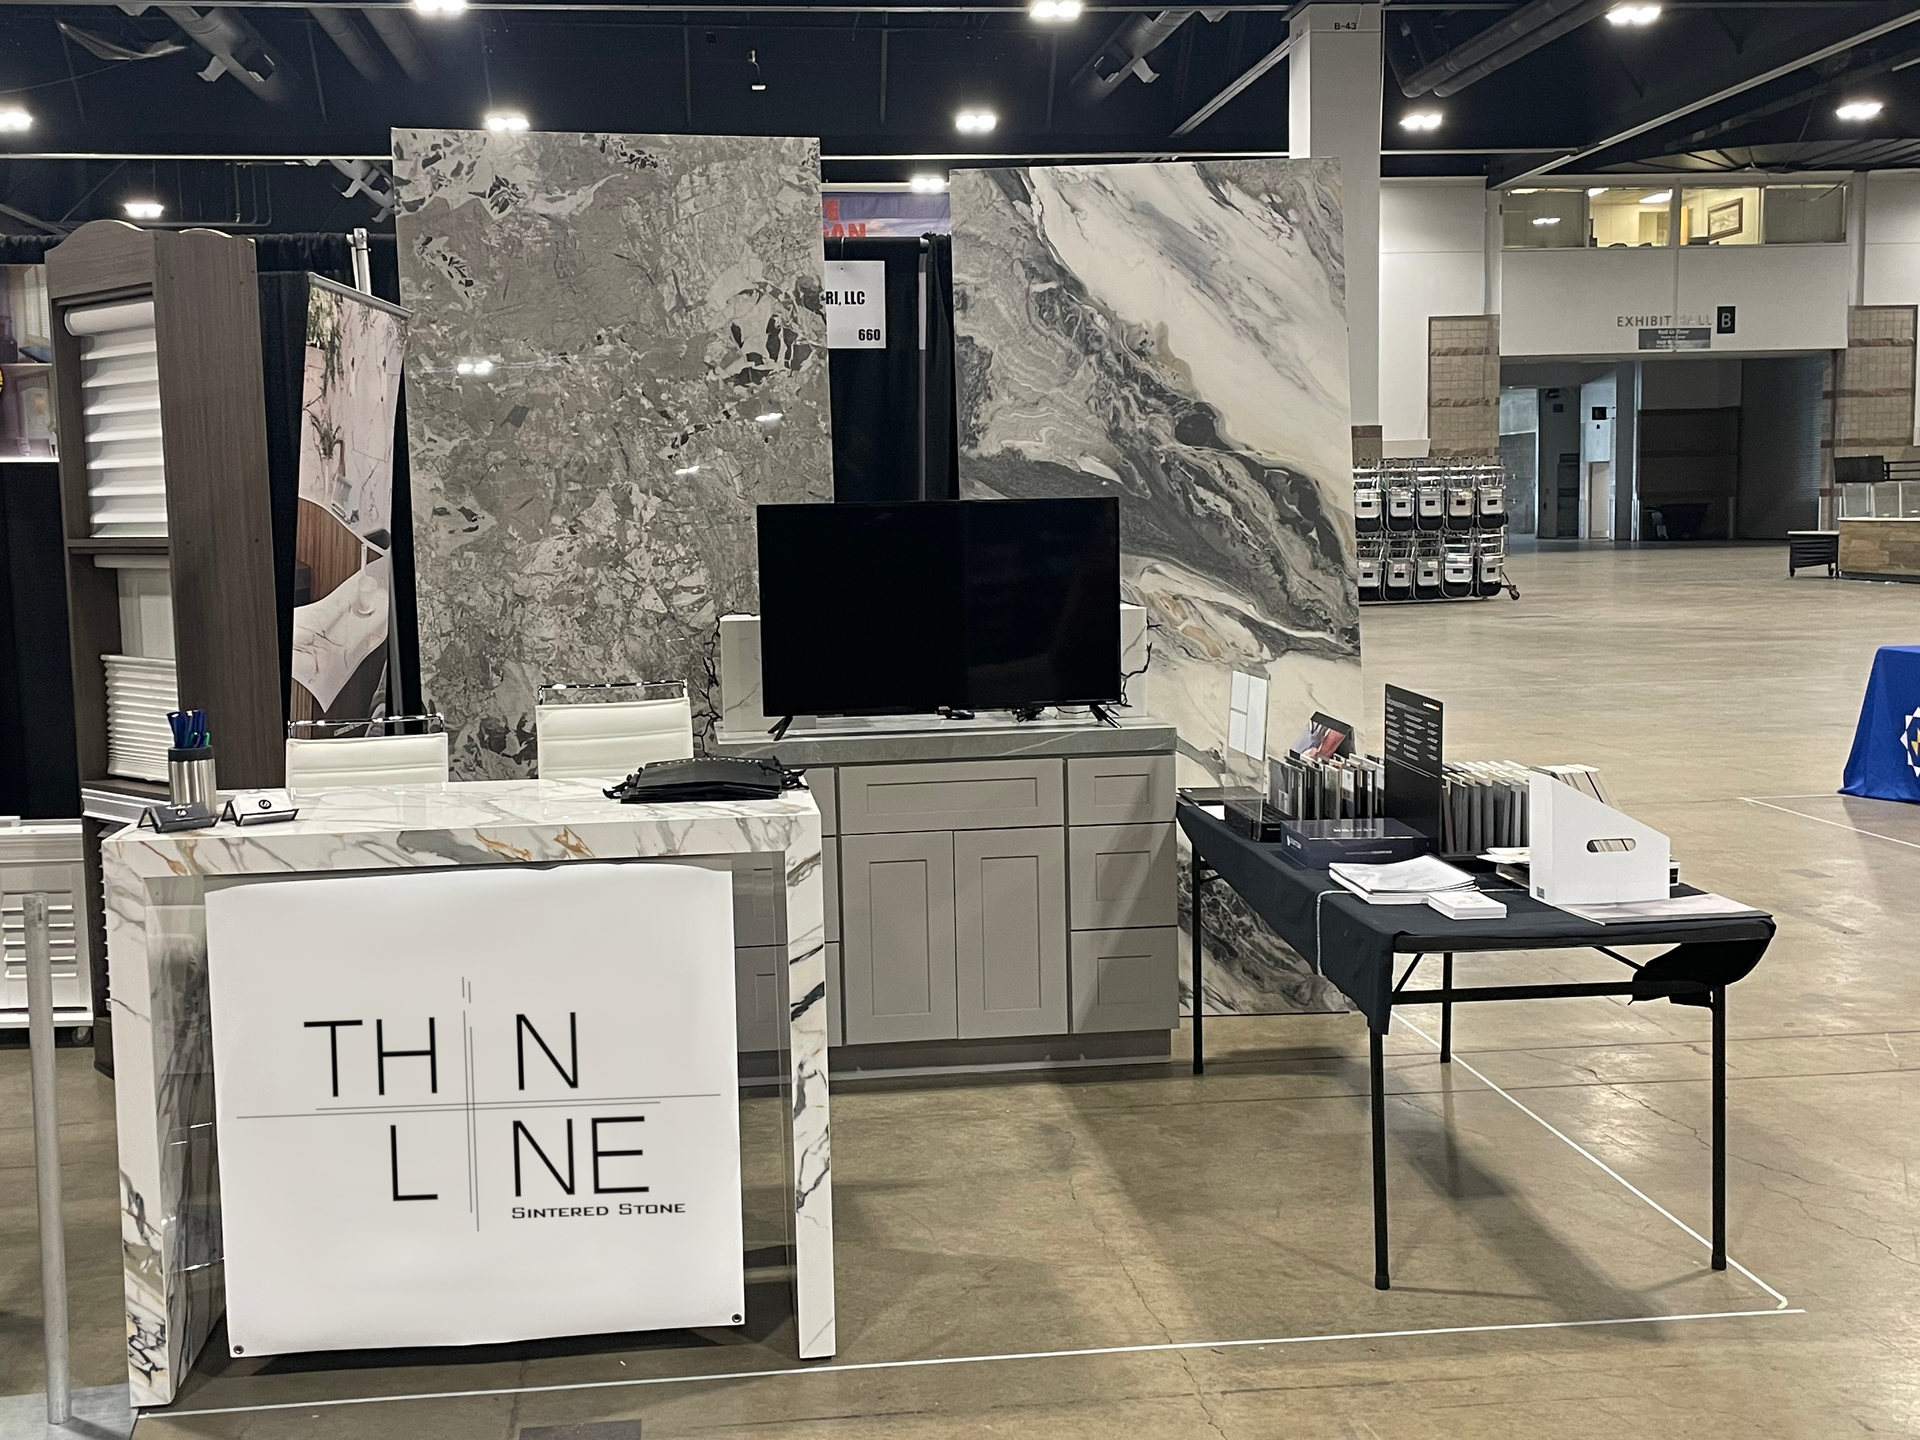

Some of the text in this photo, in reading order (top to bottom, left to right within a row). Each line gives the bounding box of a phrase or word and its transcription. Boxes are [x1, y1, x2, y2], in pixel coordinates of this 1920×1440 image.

[1334, 22, 1357, 30] B-43
[844, 291, 865, 305] LLC
[1617, 315, 1672, 327] EXHIBIT
[1721, 312, 1732, 328] B
[858, 329, 881, 341] 660
